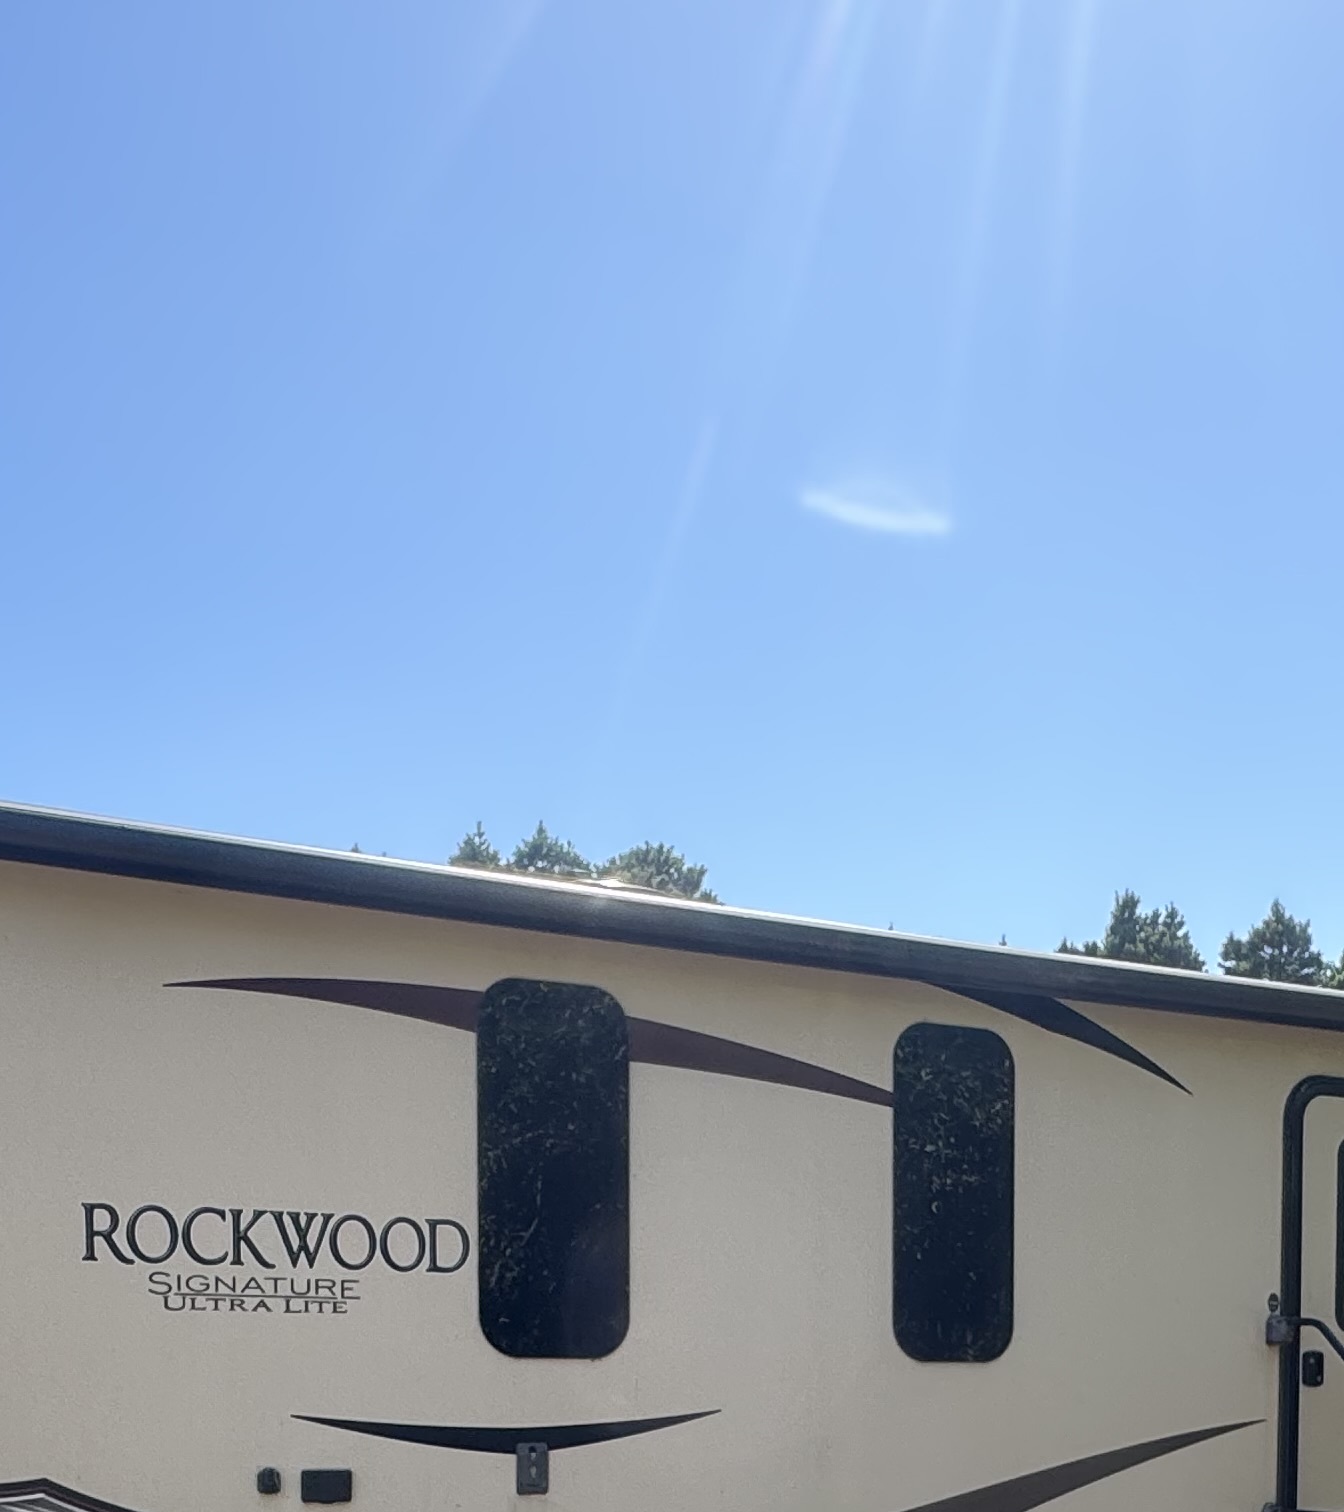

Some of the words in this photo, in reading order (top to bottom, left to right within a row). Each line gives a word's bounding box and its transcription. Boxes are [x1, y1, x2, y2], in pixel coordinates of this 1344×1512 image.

[81, 1202, 470, 1273] ROCKWOOD
[148, 1272, 361, 1300] SIGNATURE
[163, 1295, 273, 1313] ULTRA
[284, 1299, 348, 1314] LITE
